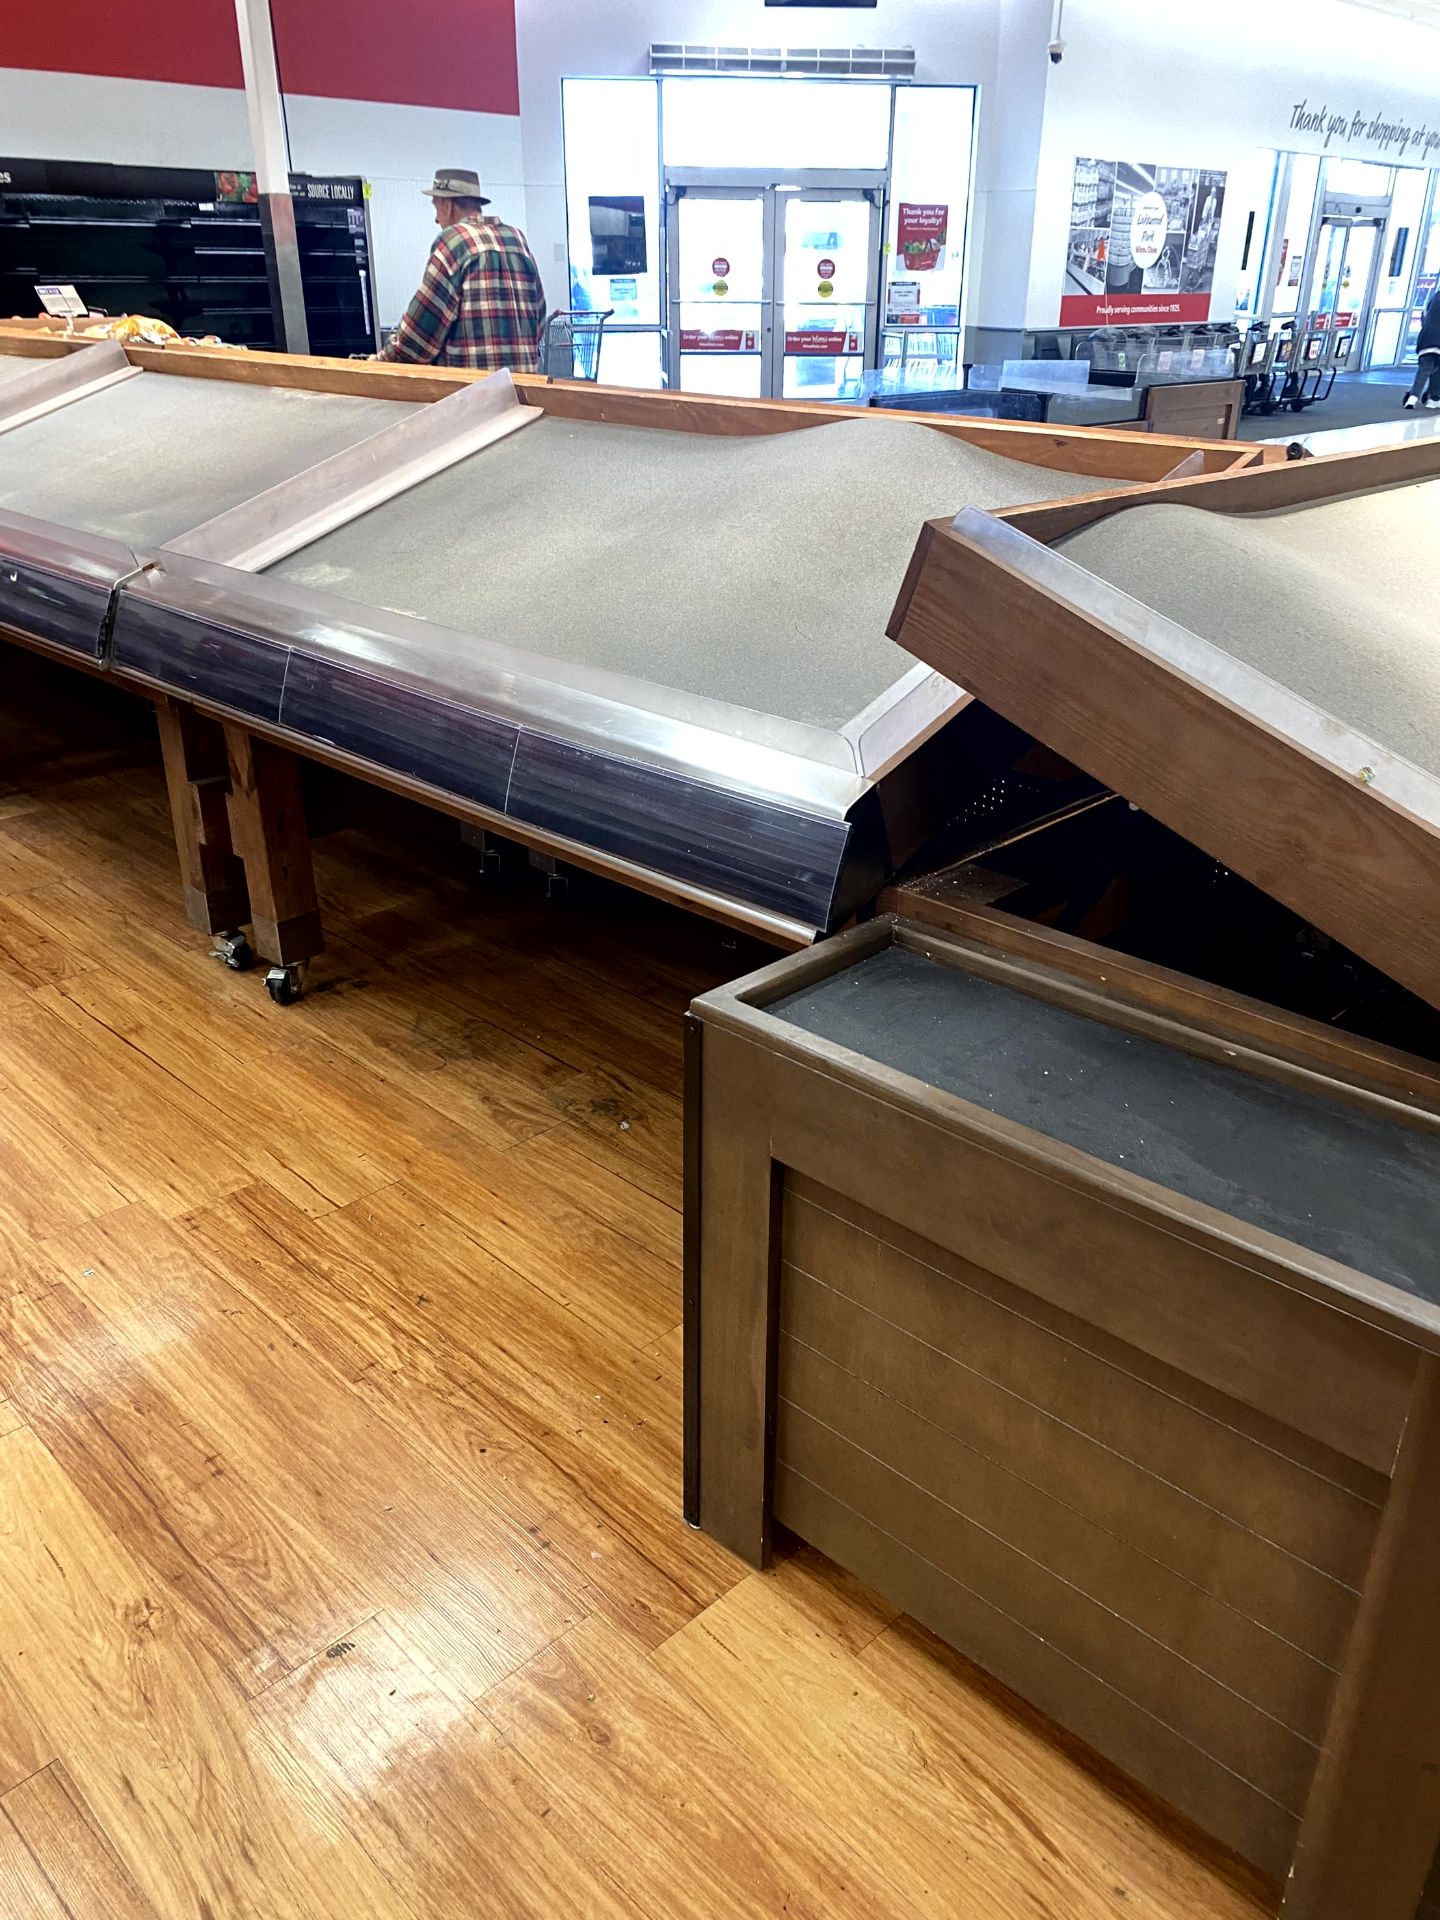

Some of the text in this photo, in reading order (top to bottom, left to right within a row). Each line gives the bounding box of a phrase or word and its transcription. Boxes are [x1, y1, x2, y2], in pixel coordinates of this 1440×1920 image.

[1289, 98, 1328, 133] Thank
[1326, 114, 1348, 149] you
[1347, 109, 1367, 142] for
[1366, 111, 1411, 156] shopping
[1410, 123, 1427, 146] at
[306, 183, 330, 199] SOURCE
[330, 184, 354, 200] LOCALLY
[903, 207, 945, 217] Thank you for
[904, 216, 942, 226] your loyalty!
[1096, 305, 1114, 316] Proudly
[1114, 305, 1130, 316] serving
[1130, 304, 1158, 313] communities
[1158, 304, 1169, 313] since
